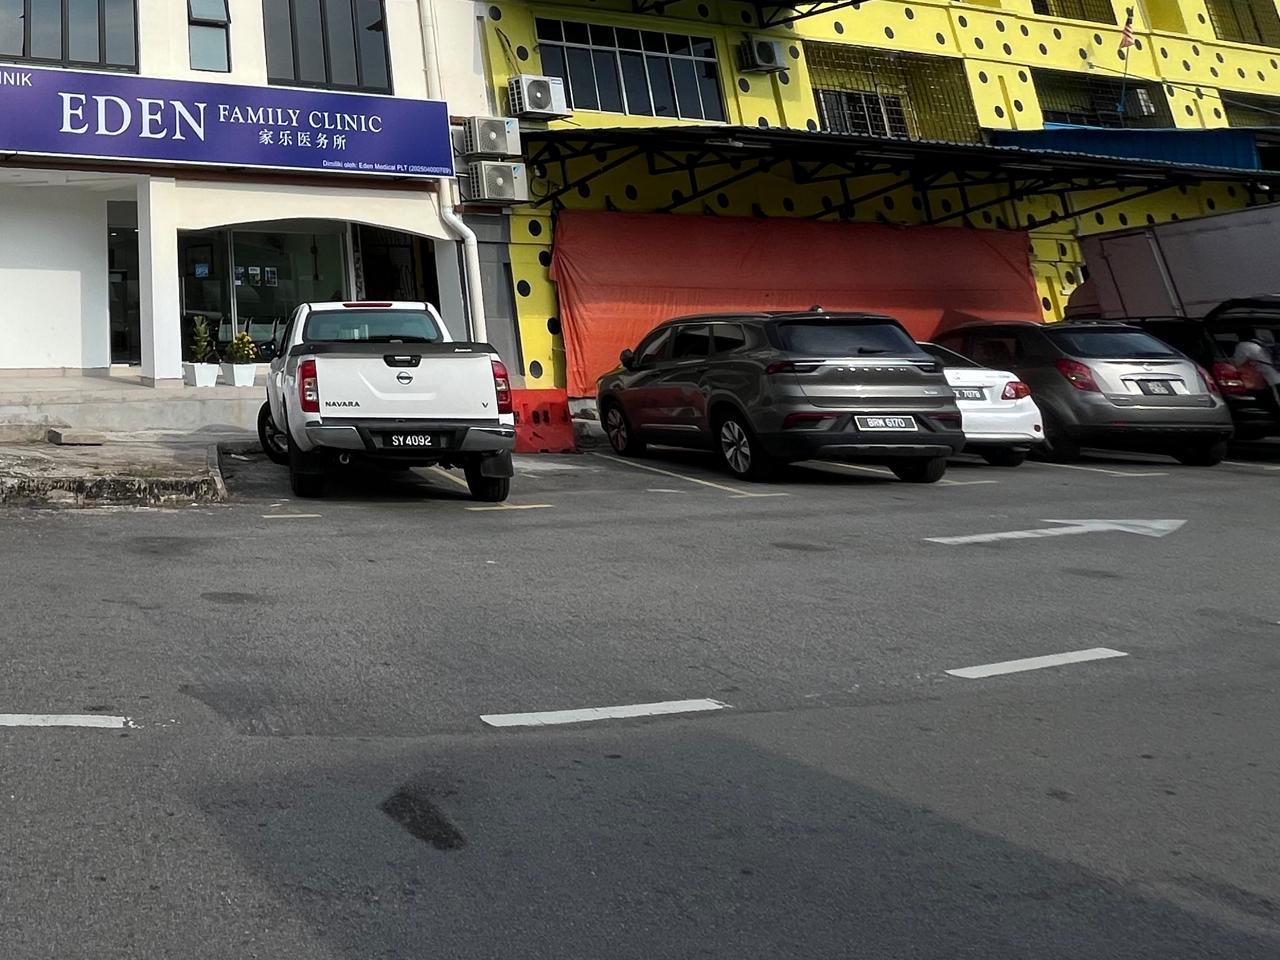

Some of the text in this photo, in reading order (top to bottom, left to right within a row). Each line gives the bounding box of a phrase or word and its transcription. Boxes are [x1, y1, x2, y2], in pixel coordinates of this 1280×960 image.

[58, 92, 383, 141] EDEN FAMILY CLINIC
[258, 128, 347, 150] 家乐医务所
[374, 163, 396, 171] Medical
[885, 418, 906, 427] 6170
[392, 435, 432, 446] SY 4092
